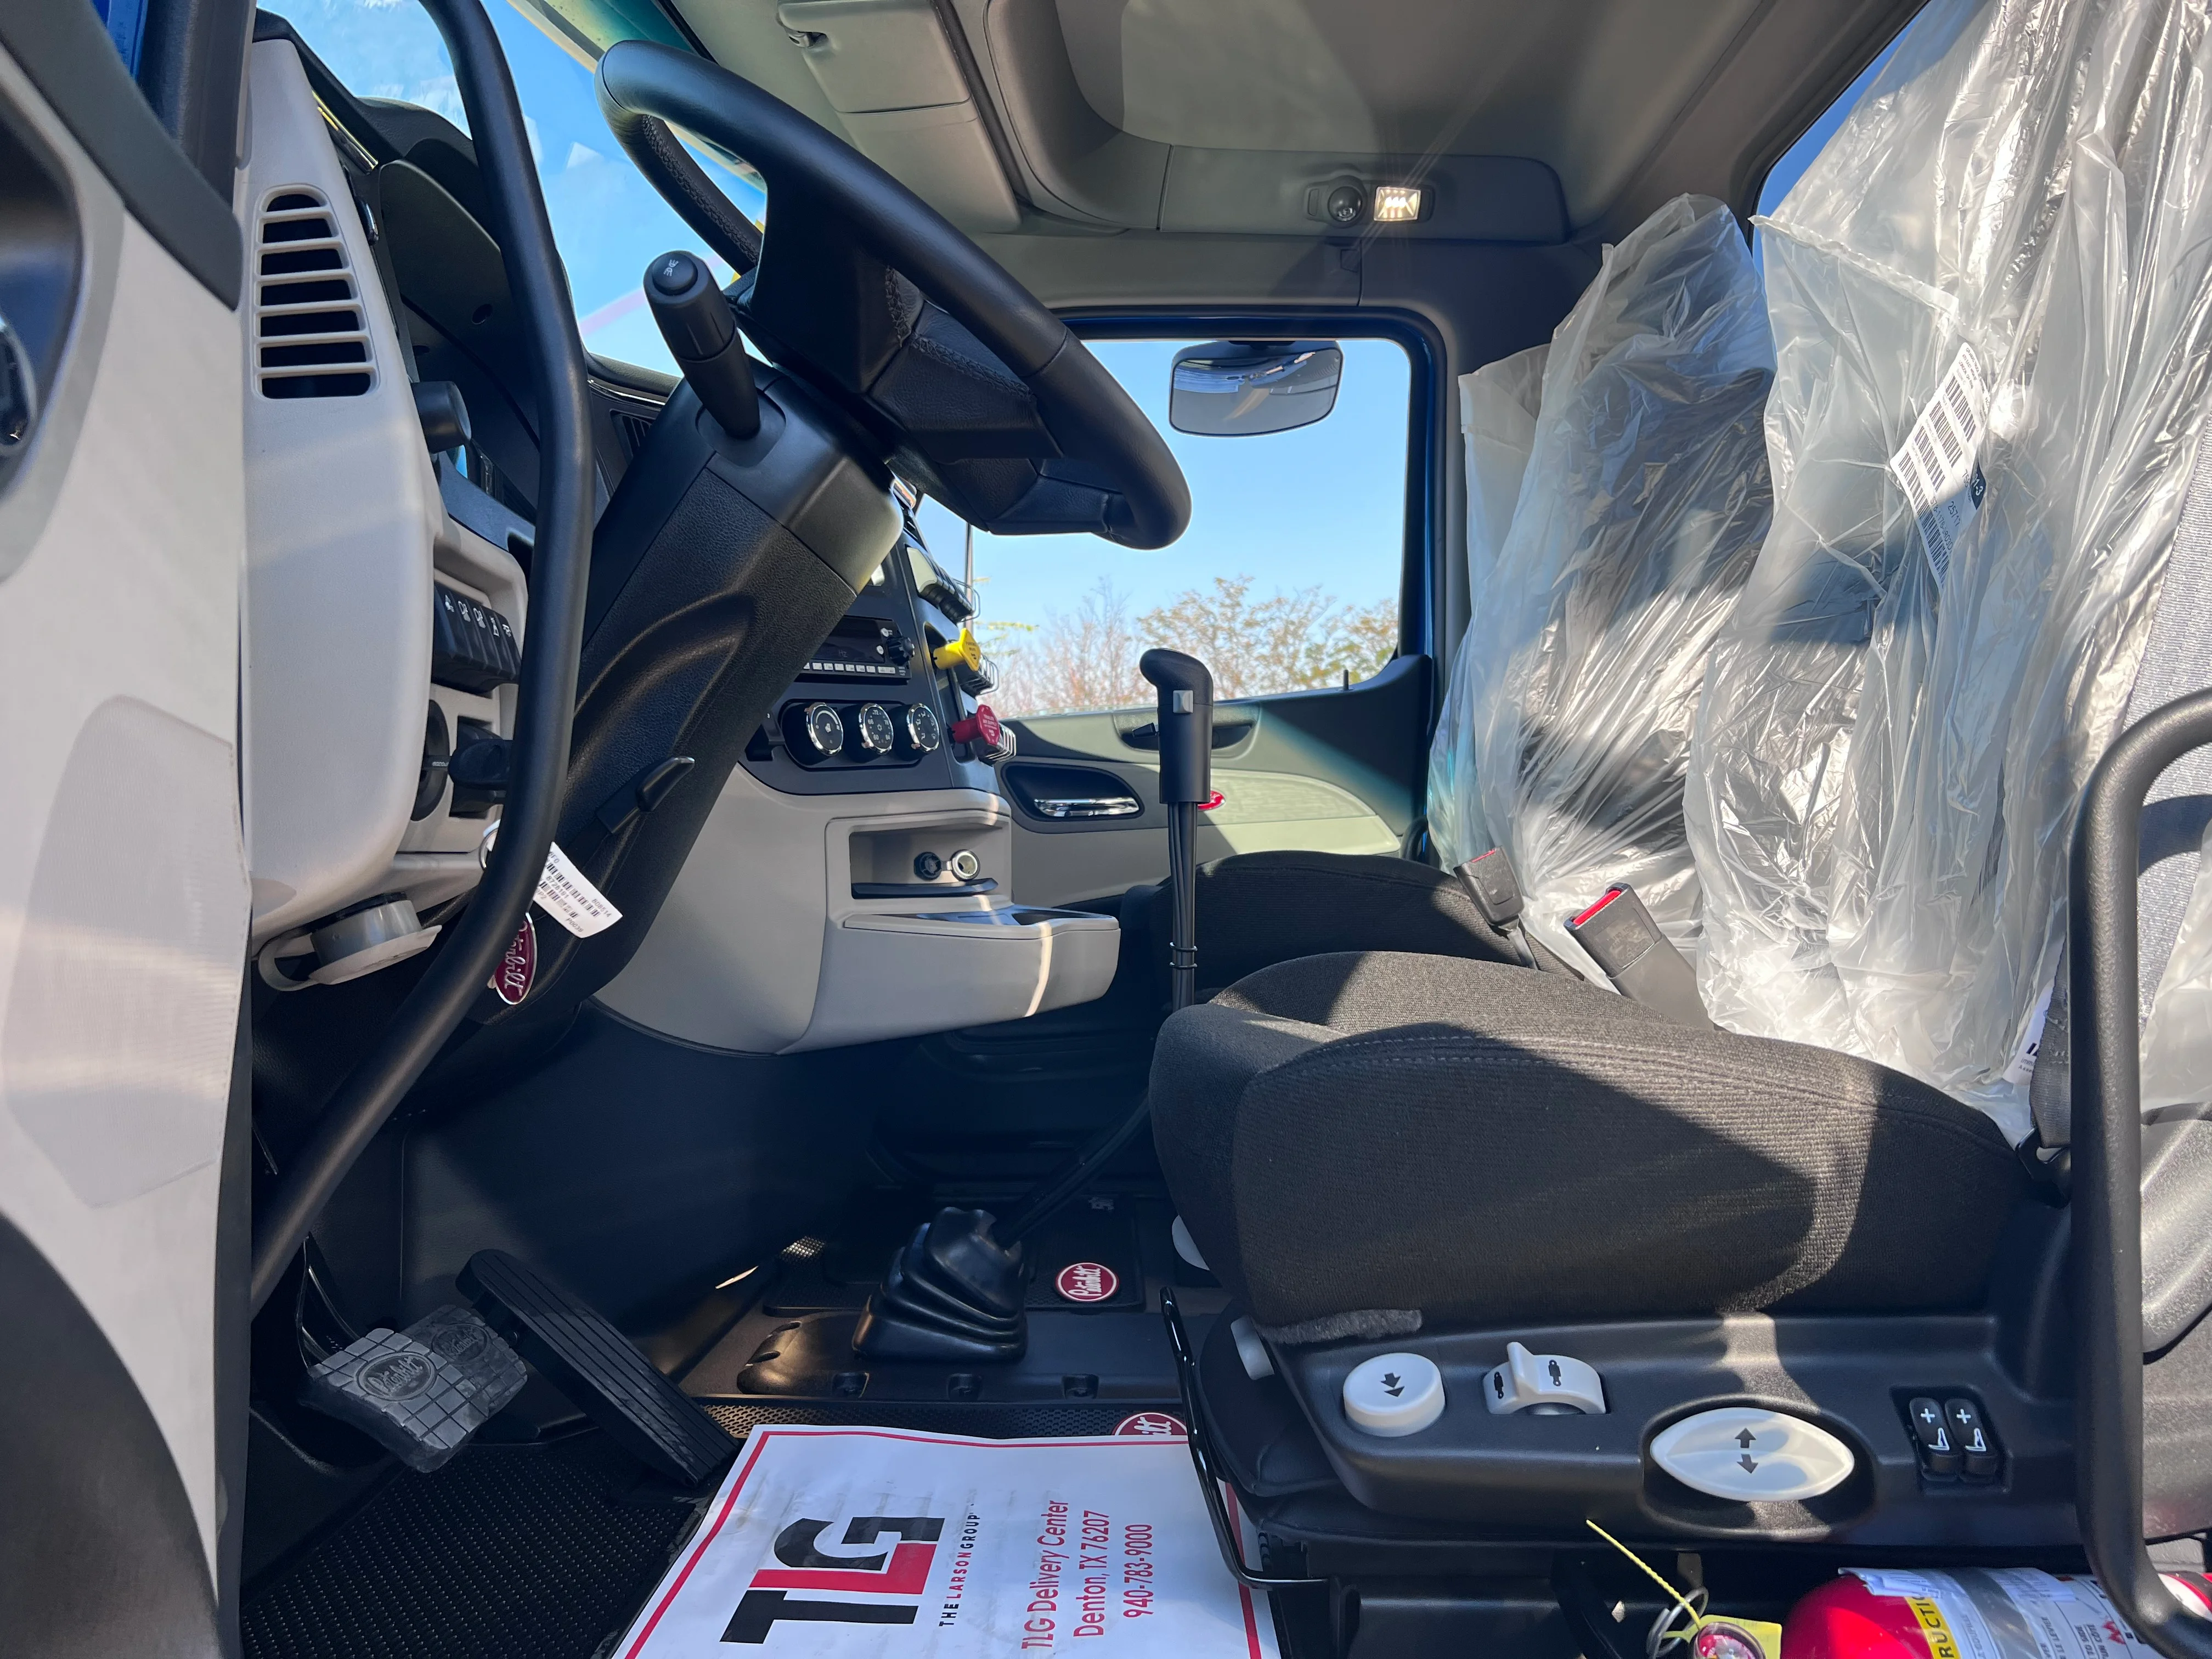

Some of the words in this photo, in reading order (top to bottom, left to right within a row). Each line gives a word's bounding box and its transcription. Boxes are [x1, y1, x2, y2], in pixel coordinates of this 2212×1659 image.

[504, 920, 528, 997] trbilt
[1068, 1265, 1102, 1296] Peterbilt
[1037, 1500, 1069, 1546] Center
[1081, 1510, 1110, 1550] 76207
[720, 1517, 945, 1644] TLG
[946, 1552, 972, 1599] LARSON
[1026, 1550, 1070, 1613] Delivery
[1079, 1555, 1108, 1570] TX
[1123, 1524, 1154, 1618] 940-783-9000
[939, 1603, 959, 1627] THE
[1073, 1573, 1110, 1637] Denton,
[1021, 1618, 1056, 1649] TLG
